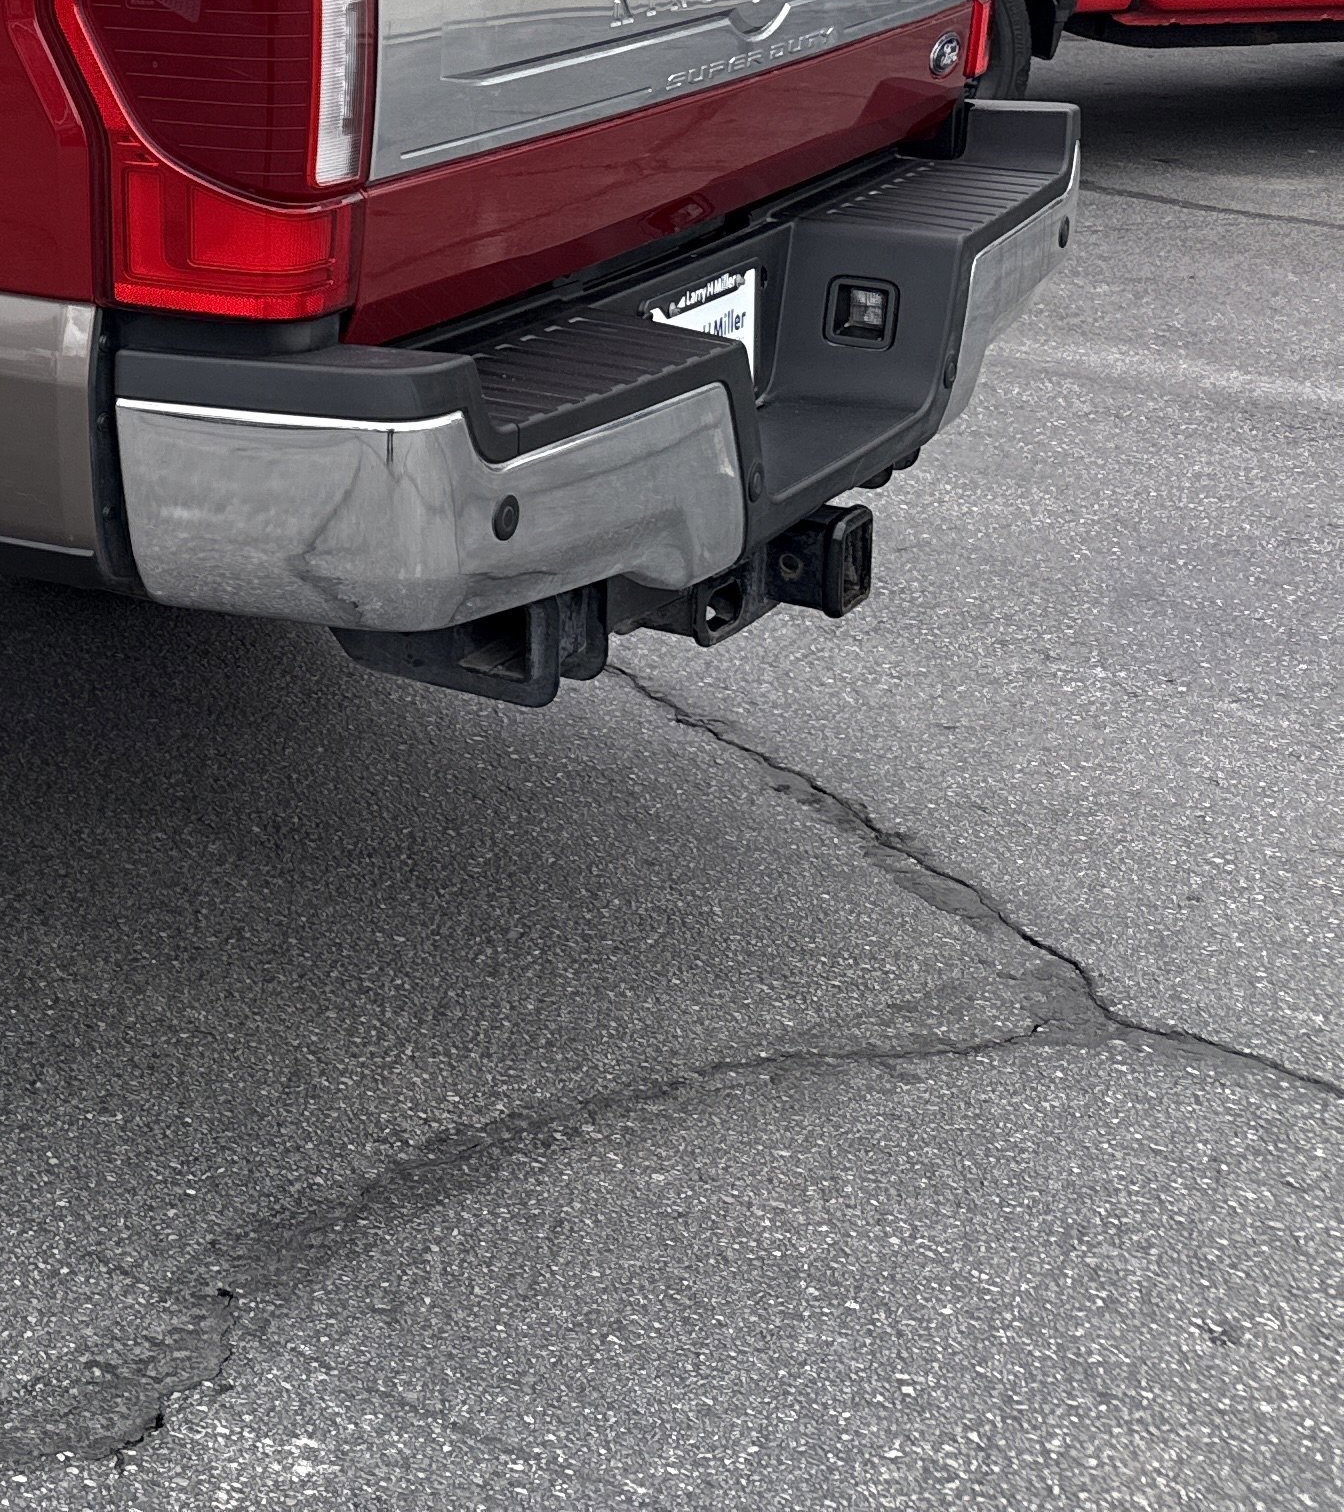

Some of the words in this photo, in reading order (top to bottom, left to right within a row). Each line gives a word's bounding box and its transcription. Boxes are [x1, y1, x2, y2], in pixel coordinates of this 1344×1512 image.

[665, 51, 762, 92] SUPER
[770, 25, 835, 59] DUTY
[686, 287, 707, 307] Larry
[706, 281, 715, 297] H
[714, 272, 736, 295] Miller
[714, 308, 747, 337] Miller
